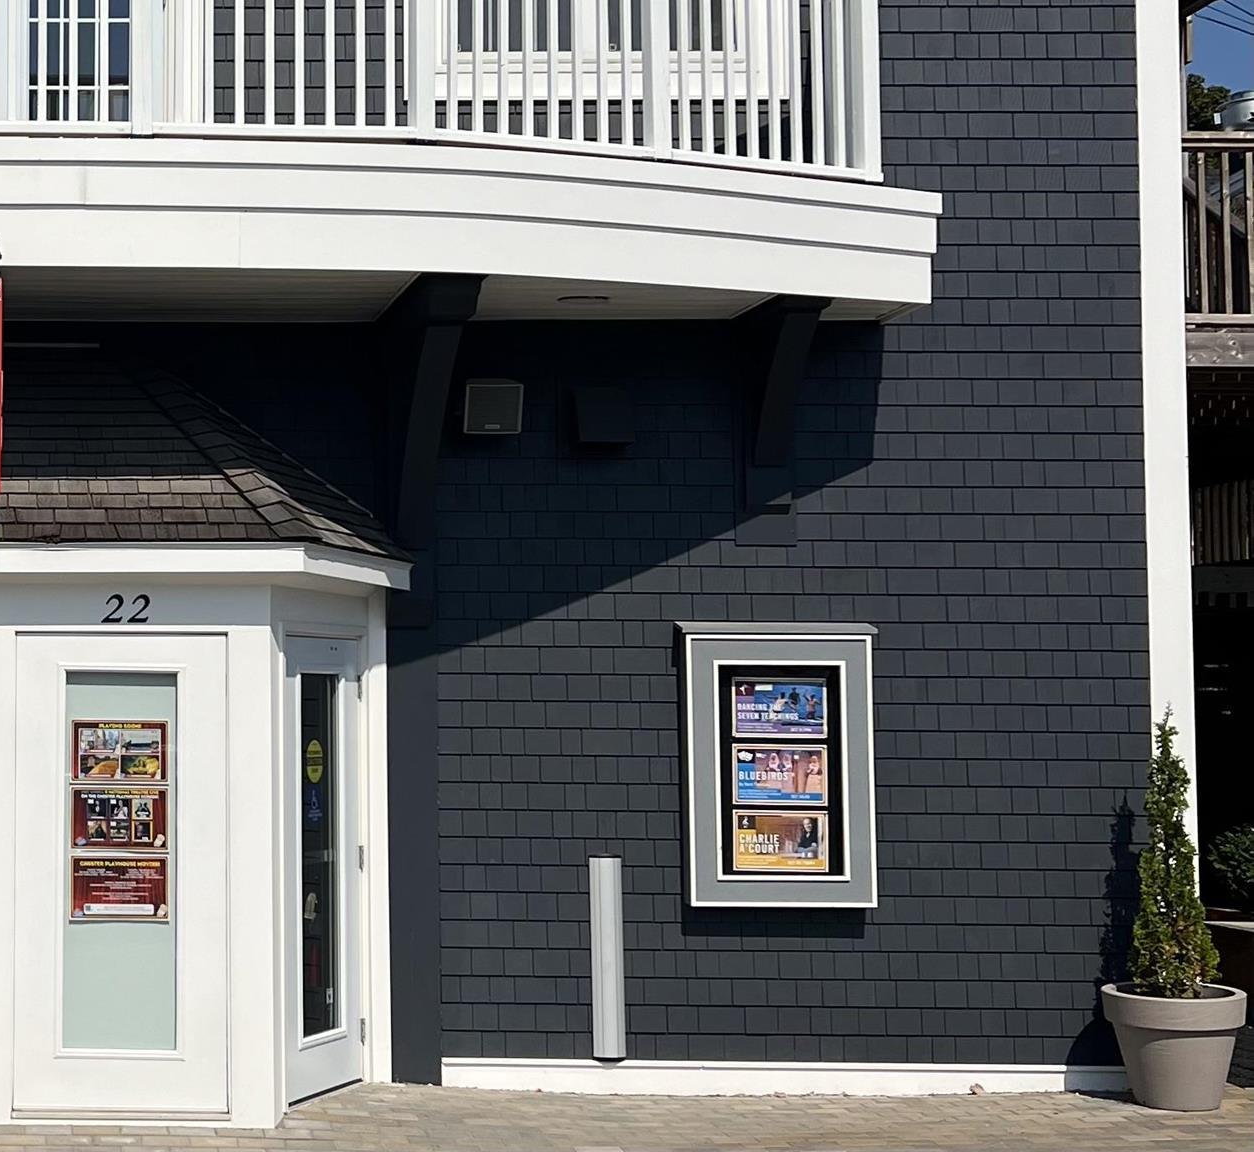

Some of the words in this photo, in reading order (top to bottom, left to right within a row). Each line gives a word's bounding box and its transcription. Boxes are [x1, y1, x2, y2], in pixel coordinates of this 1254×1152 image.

[100, 593, 151, 624] 22
[737, 703, 768, 711] DANCING
[737, 712, 760, 720] SEVEN
[761, 712, 799, 720] TEACHINGS
[738, 771, 788, 780] BLUEBIRDS
[739, 834, 780, 843] CHARLIE
[739, 844, 780, 853] A'COURT
